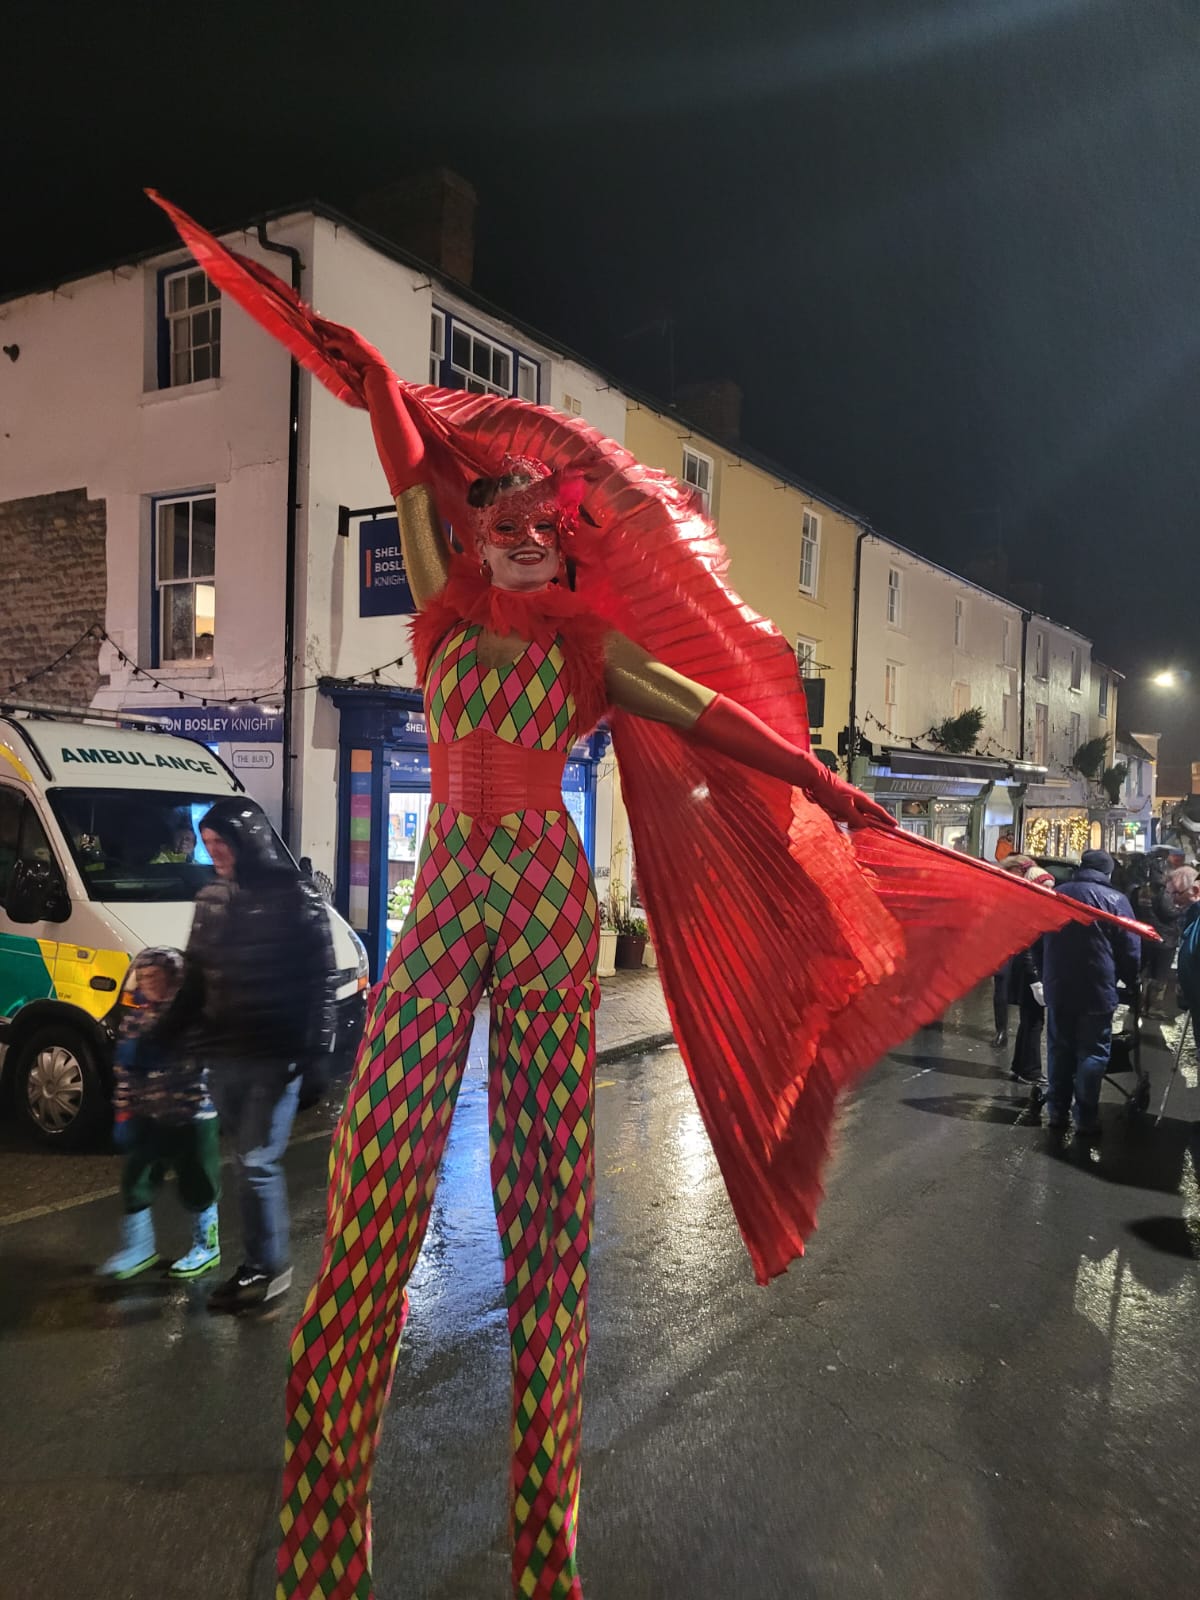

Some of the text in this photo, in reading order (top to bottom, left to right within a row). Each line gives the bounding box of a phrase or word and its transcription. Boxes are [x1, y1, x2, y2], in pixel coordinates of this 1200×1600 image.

[375, 546, 403, 558] SHEL
[375, 560, 407, 573] BOSLE
[374, 574, 407, 587] KNIGH
[184, 718, 229, 731] BOSLEY
[231, 717, 276, 731] KNIGHT
[405, 722, 427, 733] SHEL
[61, 747, 218, 776] AMBULANCE
